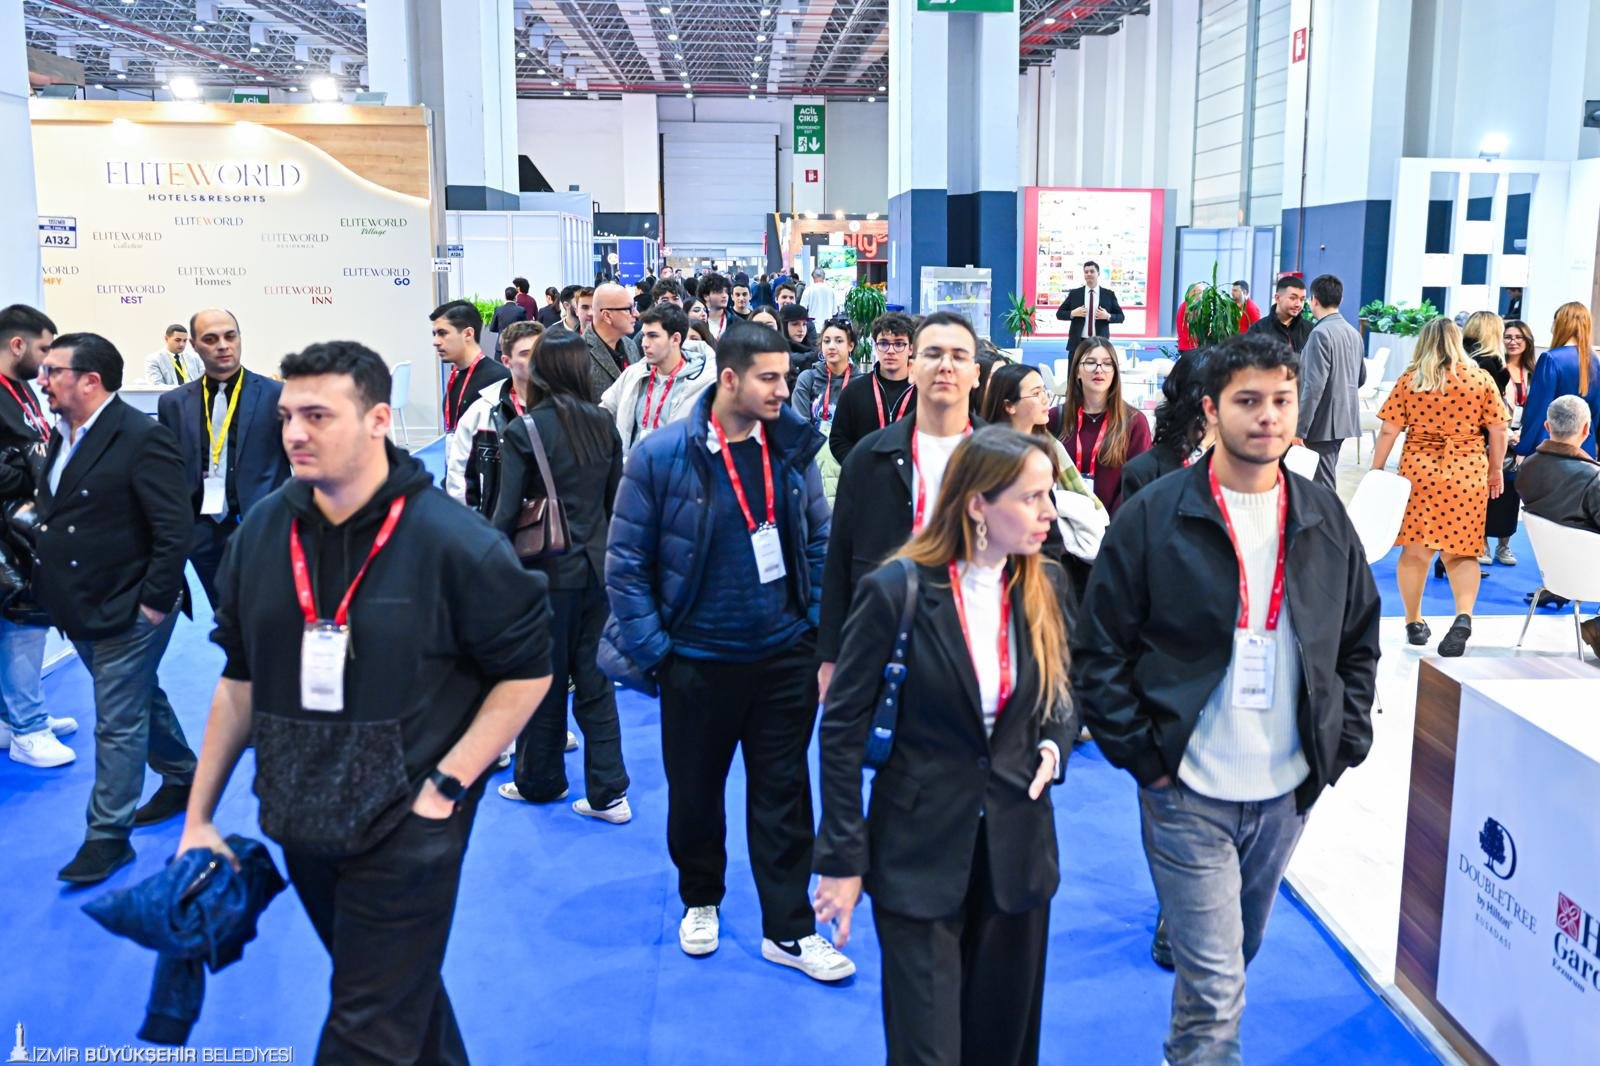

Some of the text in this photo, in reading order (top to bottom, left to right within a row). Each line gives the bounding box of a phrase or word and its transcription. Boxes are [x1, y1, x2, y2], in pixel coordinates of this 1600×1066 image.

[799, 106, 817, 115] ACİL
[798, 115, 819, 123] ÇIKIŞ
[106, 161, 301, 188] ELITEWORLD
[148, 193, 267, 204] HOTELS&RESORTS
[174, 215, 244, 227] ELITEWORLD
[340, 217, 407, 228] ELITEWORLD
[44, 235, 71, 245] A132
[92, 231, 162, 242] ELITEWORLD
[260, 233, 330, 243] ELITEWORLD
[177, 266, 247, 277] ELITEWORLD
[343, 267, 410, 278] ELITEWORLD
[195, 276, 232, 286] Homes
[394, 277, 411, 286] GO
[97, 284, 166, 295] ELITEWORLD
[264, 285, 333, 296] ELITEWORLD
[120, 295, 143, 305] NEST
[311, 296, 334, 305] INN
[1476, 892, 1514, 930] by Hilton
